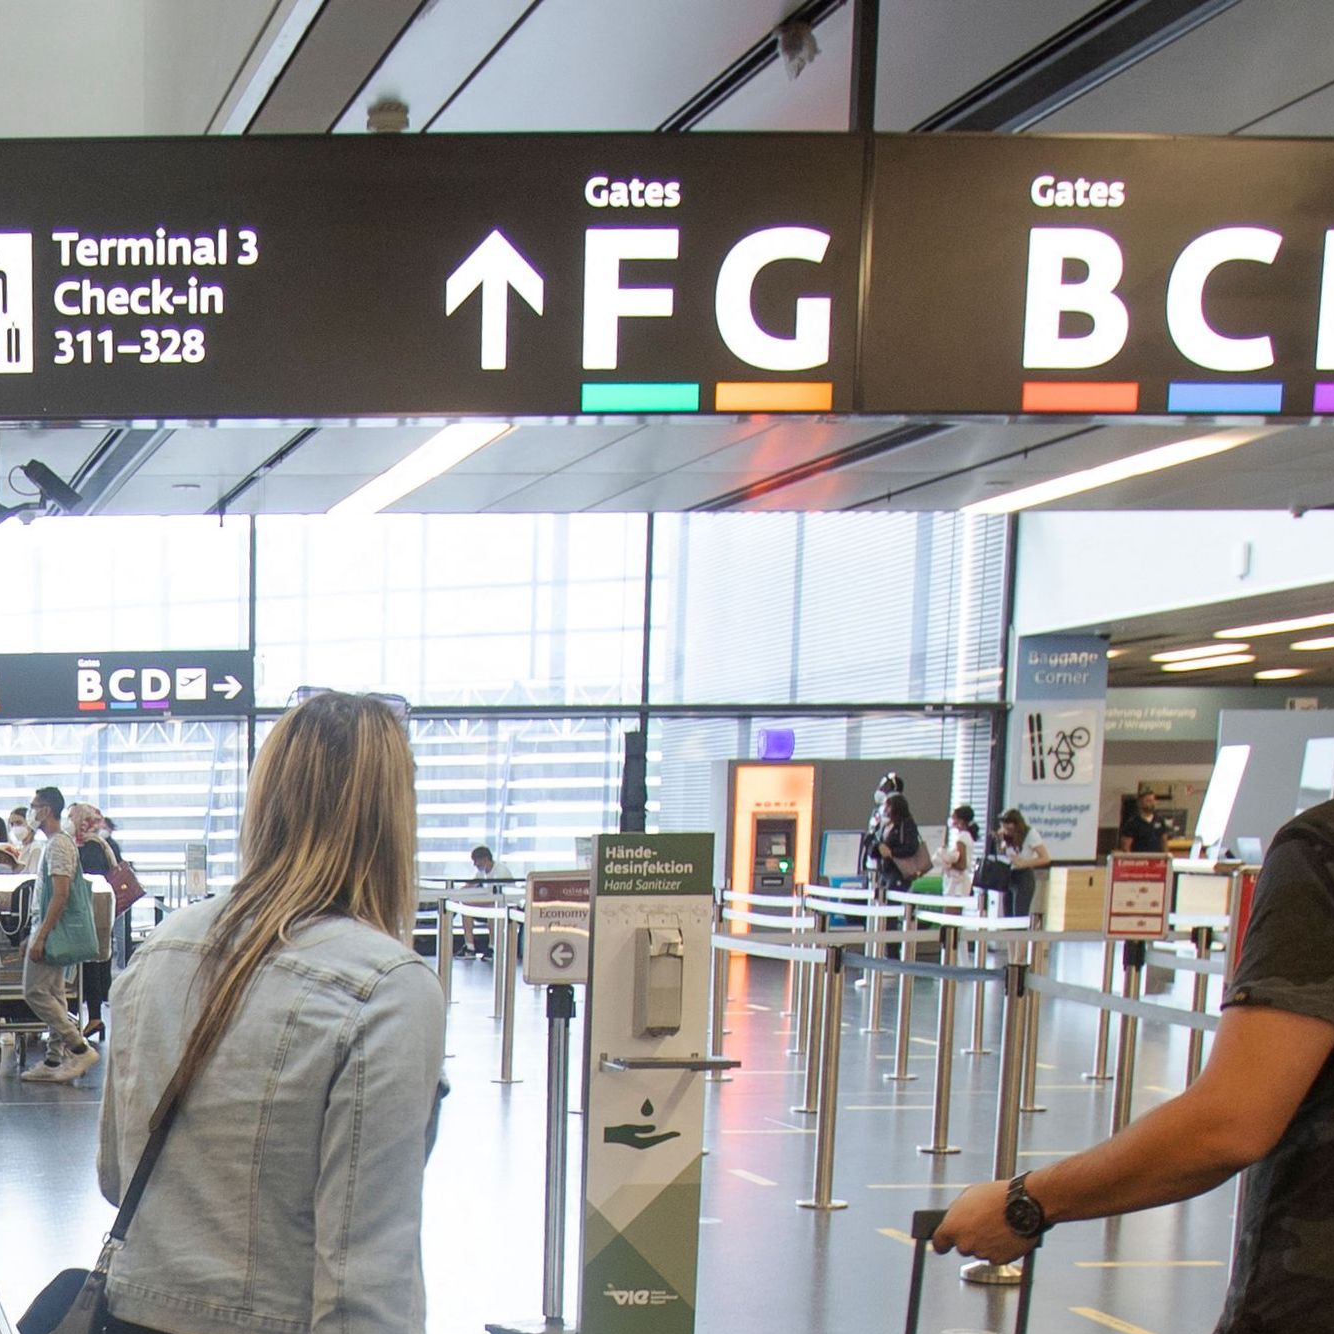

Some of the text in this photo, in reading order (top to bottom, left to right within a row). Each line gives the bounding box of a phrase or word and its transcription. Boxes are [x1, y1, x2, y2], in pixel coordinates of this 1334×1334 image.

[584, 176, 681, 207] Gates
[1030, 175, 1126, 207] Gates
[51, 227, 260, 266] Terminal 3
[53, 276, 224, 316] Check-in
[582, 226, 831, 371] F G
[1022, 228, 1129, 369] B
[1167, 226, 1283, 371] C
[1028, 651, 1099, 668] Baggage
[77, 669, 171, 702] B C D
[1035, 670, 1089, 685] Corner
[1048, 802, 1091, 814] Luggage
[605, 845, 658, 860] Hände-
[604, 860, 694, 876] desinfektion
[604, 878, 683, 892] Hand Sanitizer
[539, 908, 588, 921] Economy
